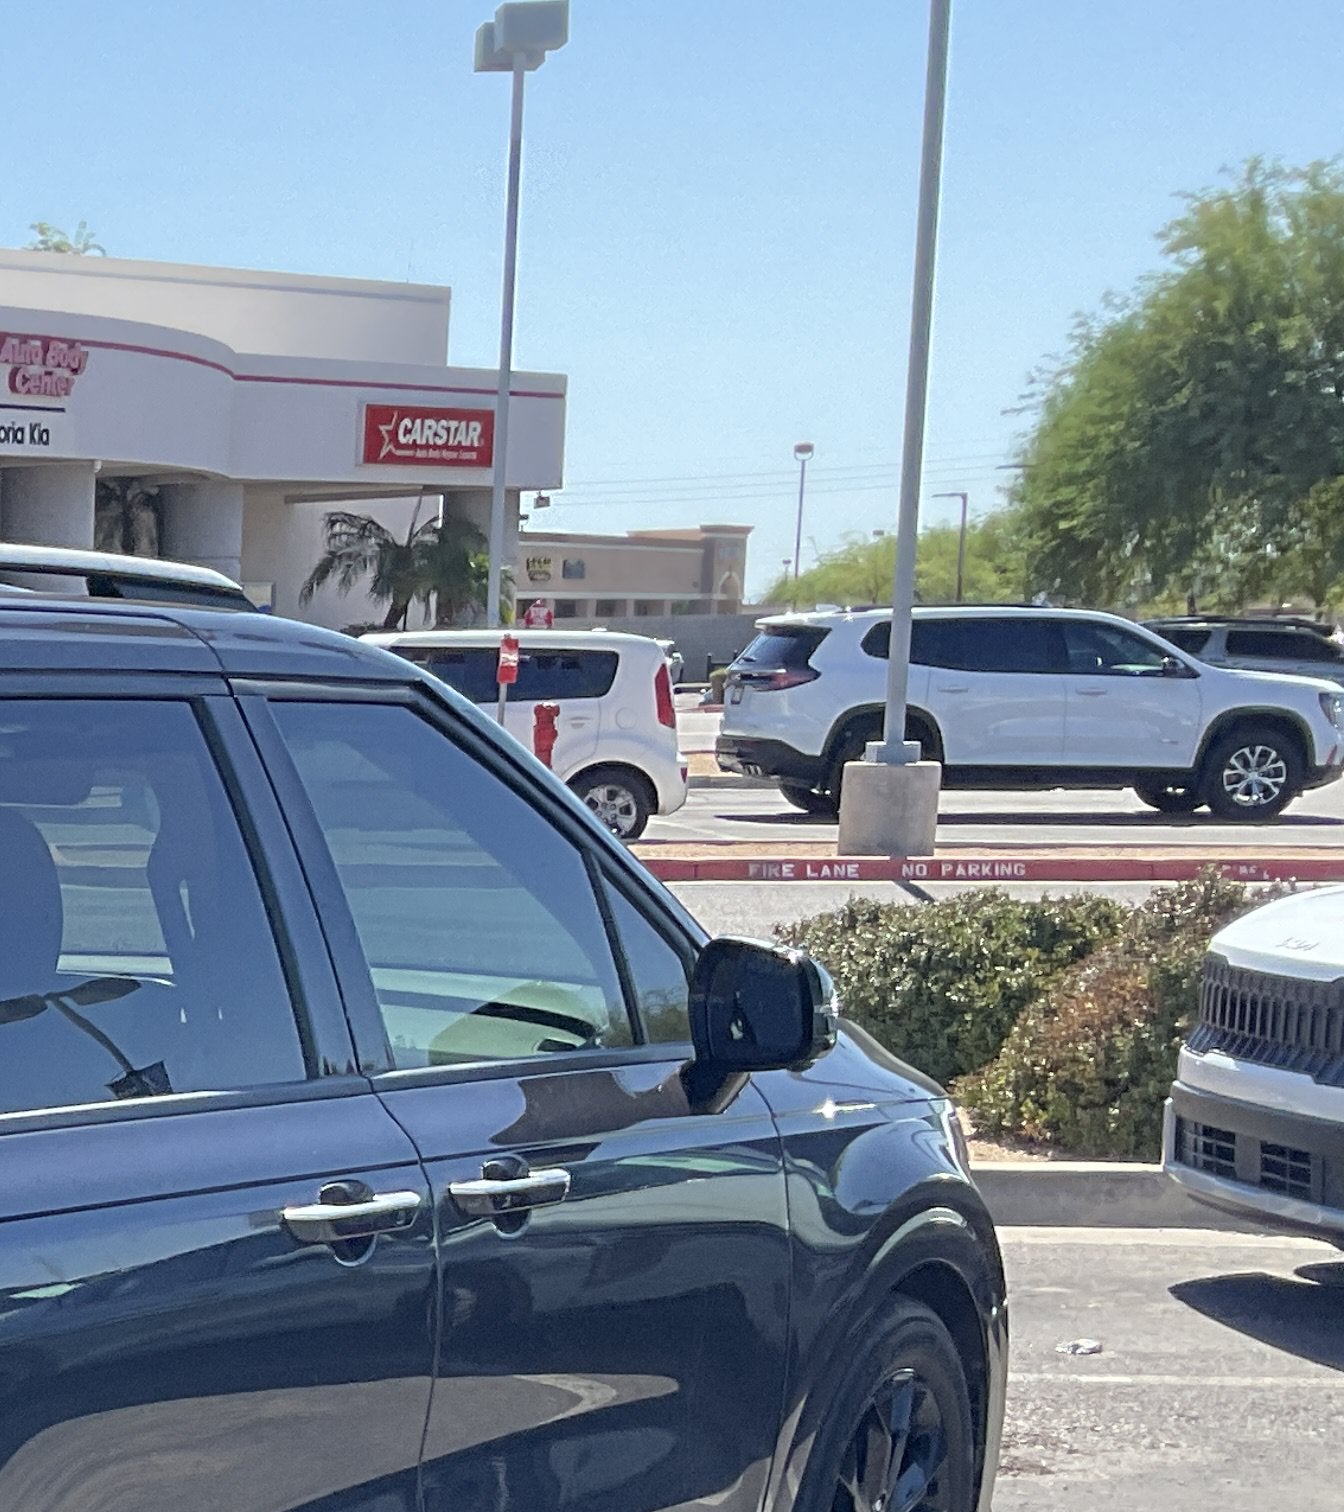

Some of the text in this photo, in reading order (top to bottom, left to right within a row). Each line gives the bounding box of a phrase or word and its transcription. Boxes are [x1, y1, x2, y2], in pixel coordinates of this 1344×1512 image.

[8, 365, 75, 396] Center
[28, 422, 50, 446] Kia
[397, 417, 481, 447] CARSTAR
[748, 862, 1026, 878] FIRE LANE NO PARKING
